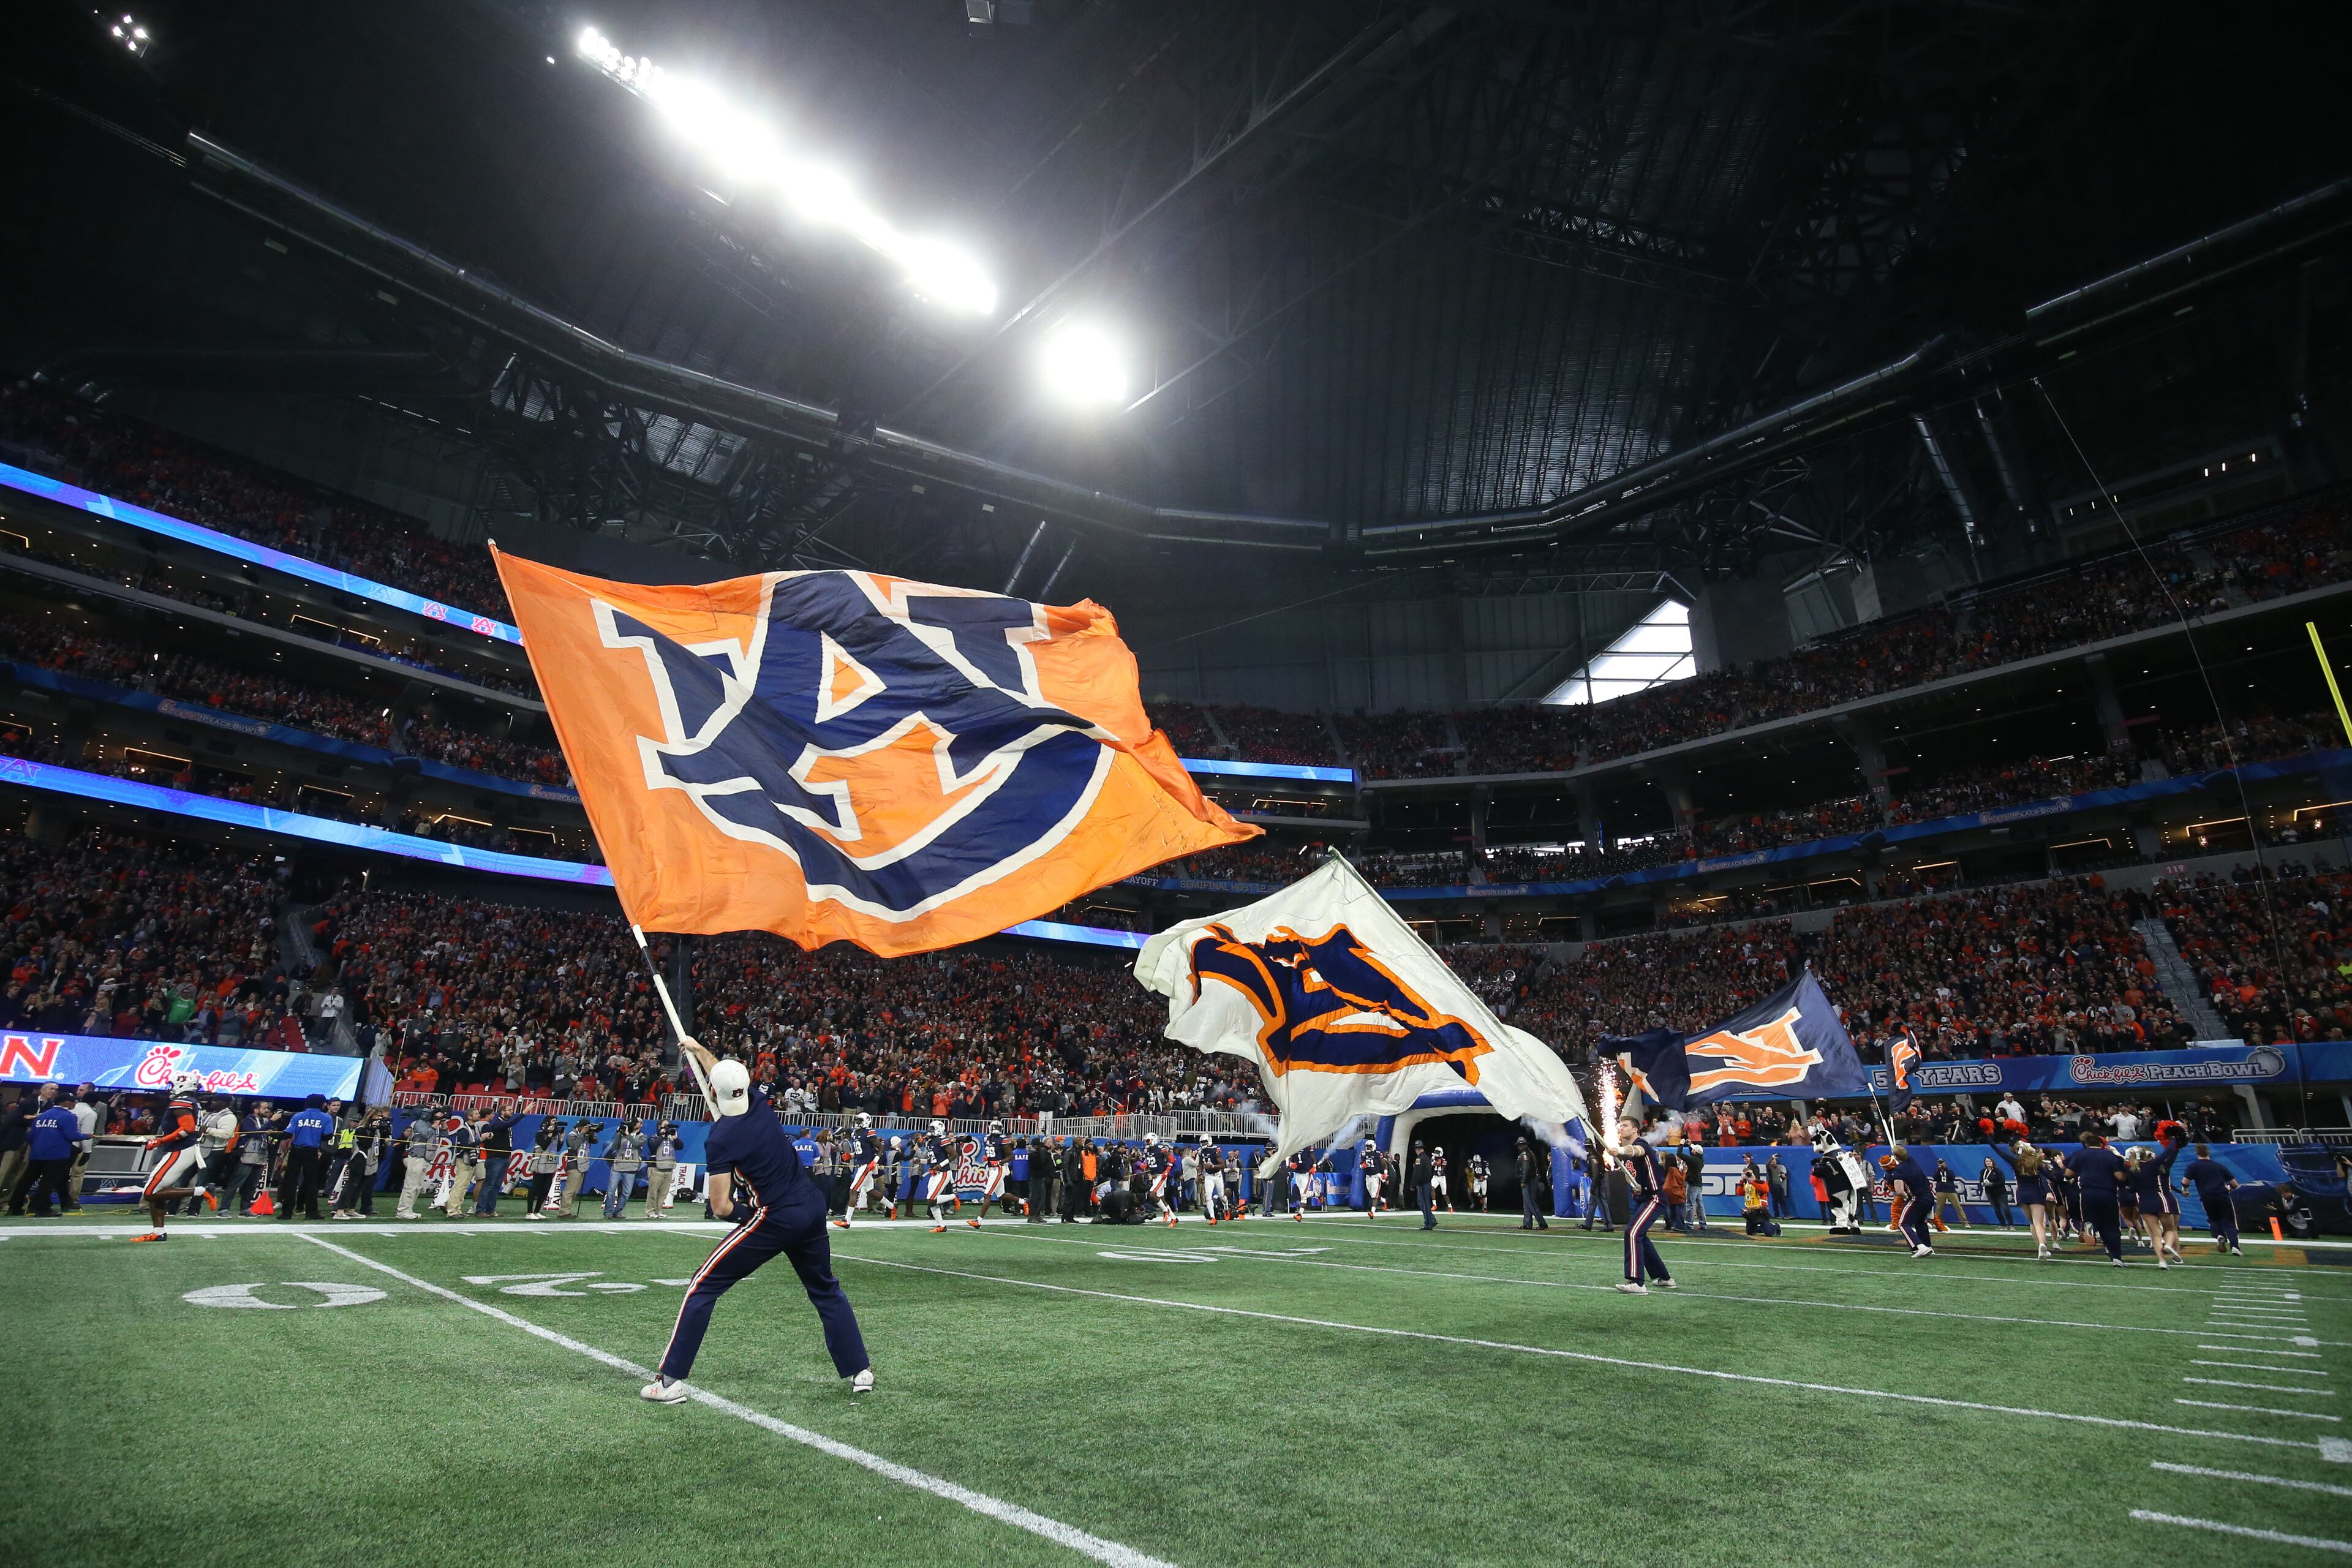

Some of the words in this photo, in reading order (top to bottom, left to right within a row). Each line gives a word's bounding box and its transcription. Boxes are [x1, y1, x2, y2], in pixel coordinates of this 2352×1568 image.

[202, 715, 231, 728] PEACH
[232, 722, 260, 734] BOWL
[2166, 864, 2185, 874] 119
[1123, 876, 1158, 886] LAYOFF
[1180, 880, 1229, 891] SEMIFINAL
[1231, 883, 1253, 893] HOST
[135, 1046, 258, 1093] Ch-fil-A
[1916, 1065, 2000, 1086] YEARS
[2073, 1056, 2147, 1083] Chick-fil-A
[2149, 1065, 2208, 1080] PEACH
[2209, 1063, 2266, 1077] BOWL
[633, 1079, 639, 1090] 2
[298, 1118, 322, 1128] S.A.F.E.
[1297, 1154, 1302, 1163] 1
[677, 1166, 687, 1186] TRACK
